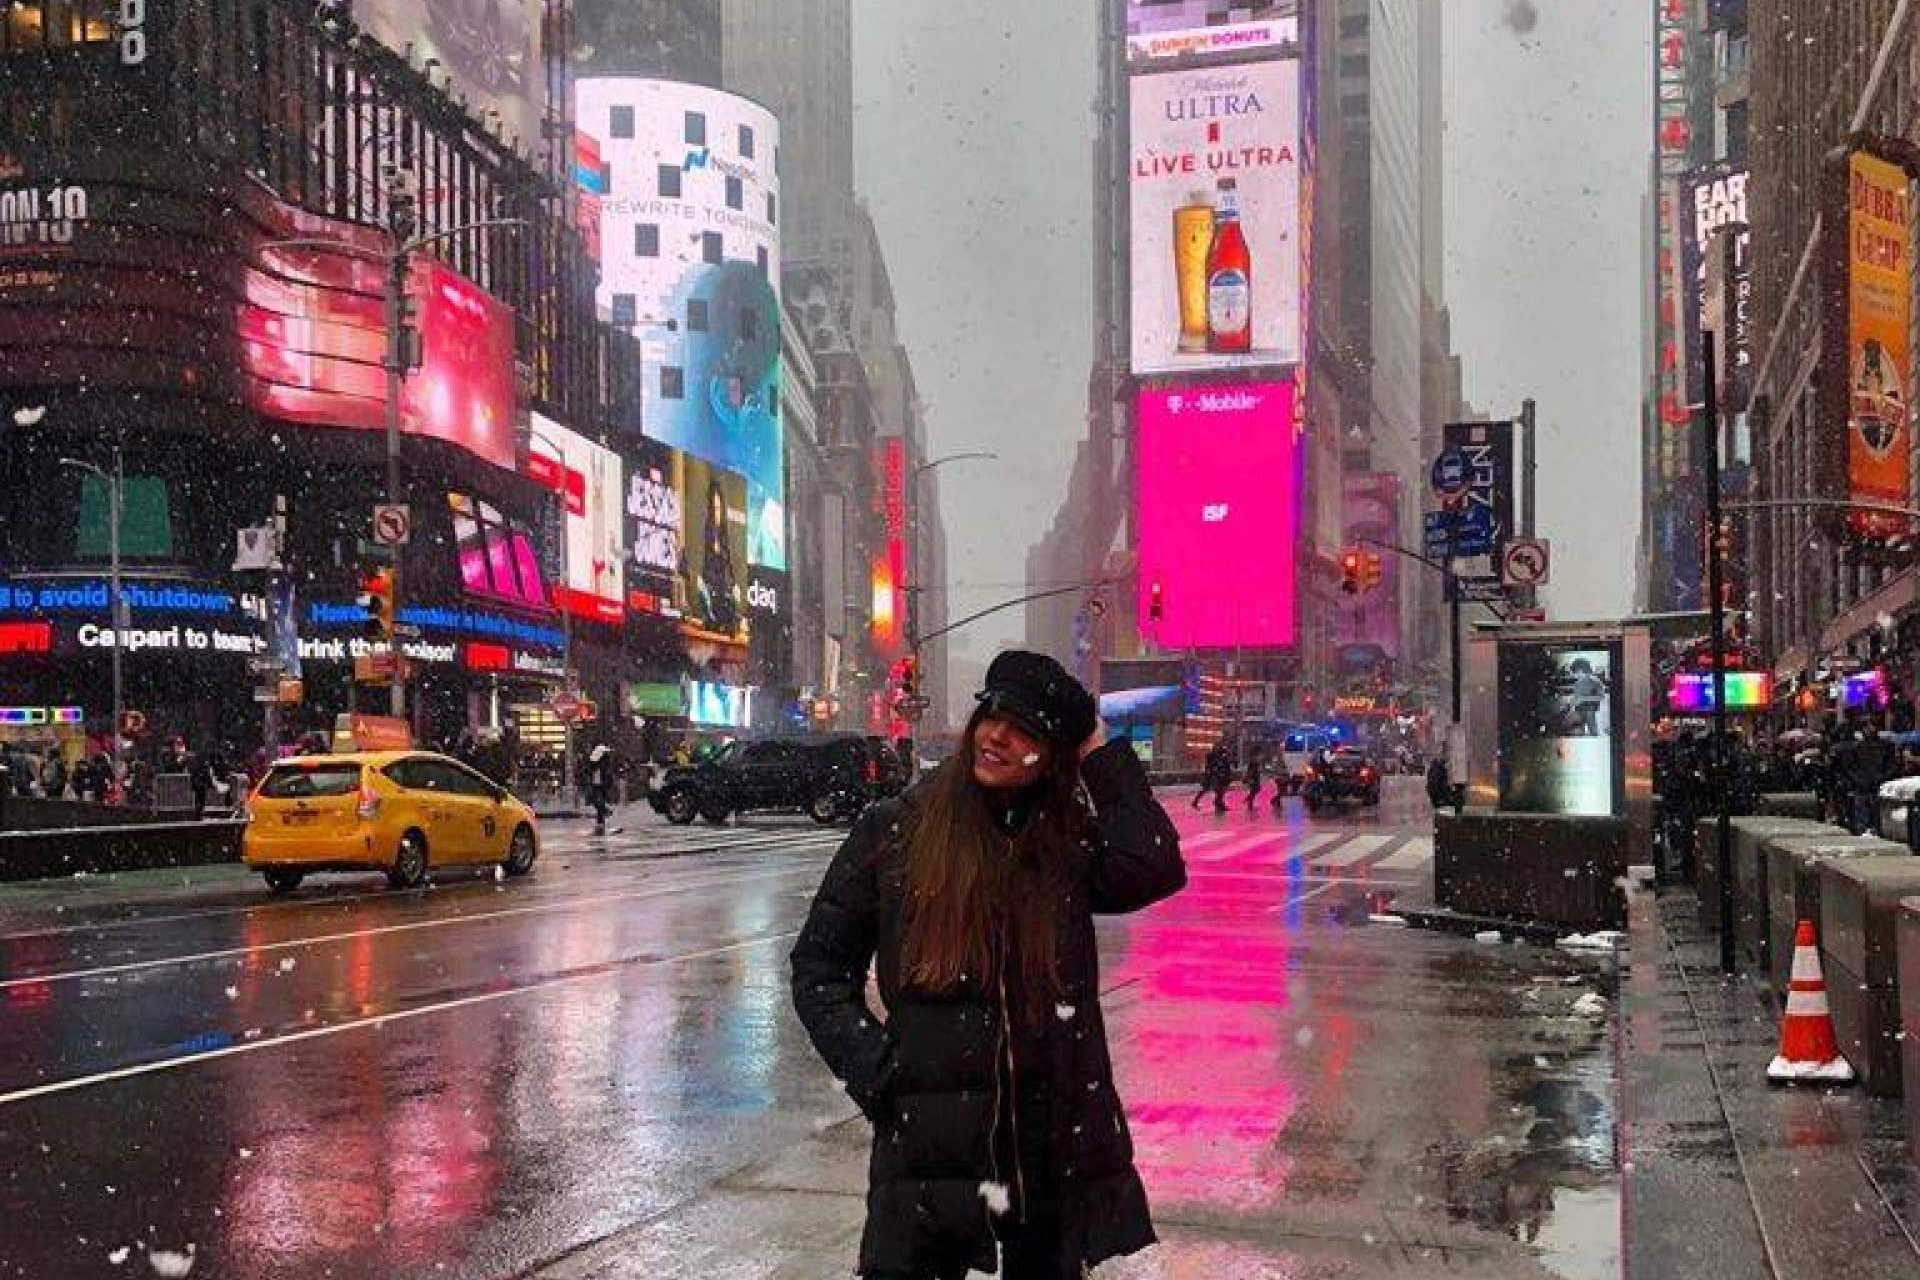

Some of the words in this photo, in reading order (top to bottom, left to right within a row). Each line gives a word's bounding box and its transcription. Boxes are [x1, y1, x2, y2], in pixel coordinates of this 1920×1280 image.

[1165, 93, 1263, 121] ULTRA
[1137, 155, 1196, 177] LIVE
[1207, 146, 1293, 170] ULTRA
[39, 583, 109, 607] avoid
[184, 627, 209, 650] to
